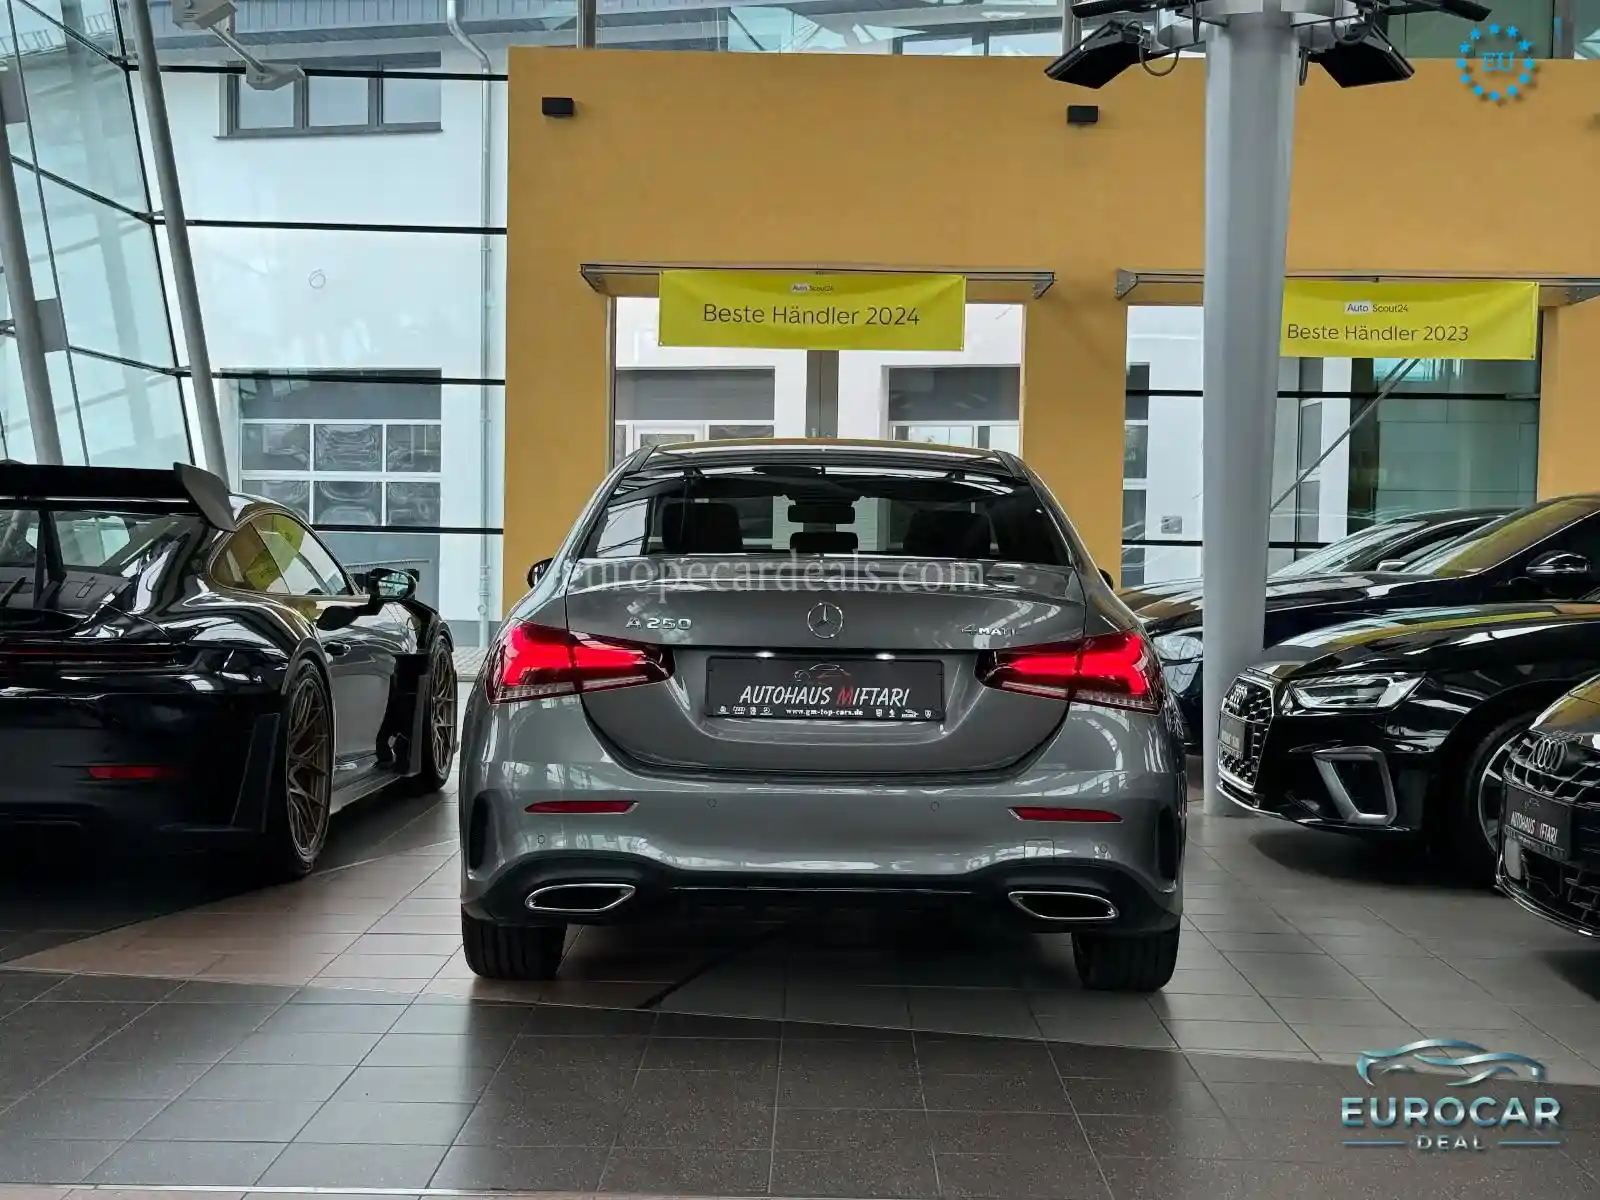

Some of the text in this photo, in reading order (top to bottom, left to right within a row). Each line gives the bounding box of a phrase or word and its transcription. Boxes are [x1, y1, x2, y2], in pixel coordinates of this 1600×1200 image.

[703, 303, 920, 326] Beste Händler 2024
[1347, 303, 1409, 314] Auto Scout24
[1287, 323, 1469, 342] Beste Händler 2023
[625, 616, 693, 630] A 250
[739, 685, 910, 708] AUTOHAUS MIFTARI
